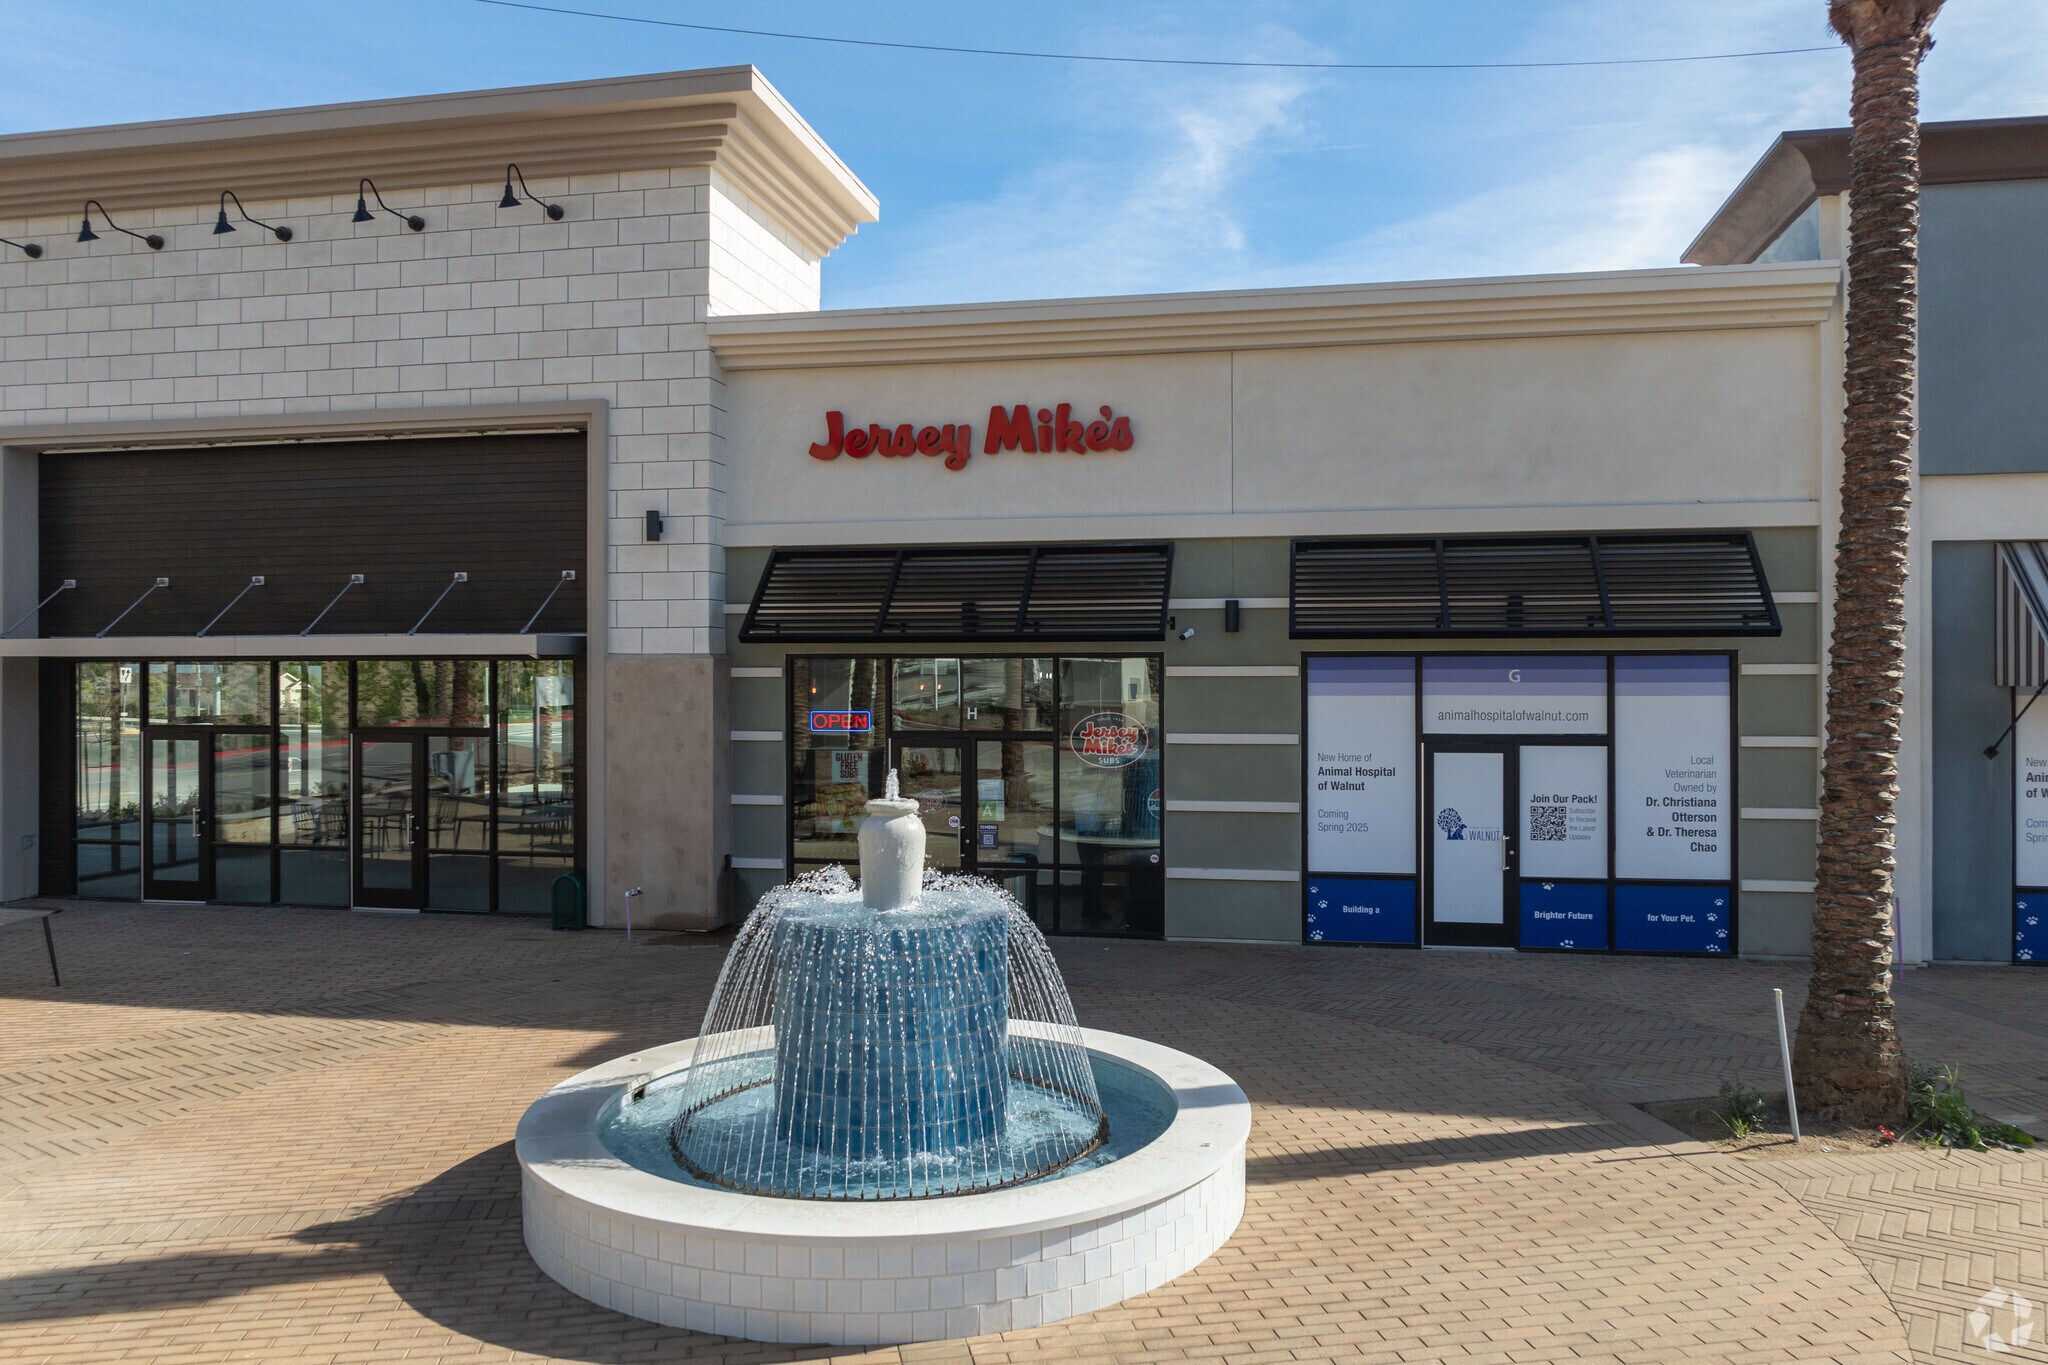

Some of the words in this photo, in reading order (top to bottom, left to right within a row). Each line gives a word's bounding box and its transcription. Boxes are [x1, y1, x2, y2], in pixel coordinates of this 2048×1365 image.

[808, 410, 972, 472] Jersey
[984, 403, 1135, 455] Mike's
[1508, 669, 1521, 682] G
[967, 707, 978, 720] H
[1438, 710, 1589, 723] animalhospitalofwalnut.com
[813, 713, 867, 728] OPEN
[1081, 722, 1138, 743] Jersey
[1083, 738, 1138, 756] Mike's
[835, 752, 863, 762] GLUTEN
[1098, 757, 1120, 765] SUBS
[1318, 753, 1335, 762] New
[1338, 753, 1362, 762] Home
[1364, 753, 1372, 762] of
[1690, 756, 1714, 765] Local
[2026, 758, 2047, 766] New
[840, 761, 858, 770] FREE
[839, 769, 859, 779] SUBS
[1318, 767, 1352, 776] Animal
[1355, 767, 1396, 778] Hospital
[1665, 769, 1717, 778] Veterinarian
[2026, 772, 2048, 782] Ani
[1318, 781, 1328, 790] of
[1330, 781, 1365, 790] Walnut
[1674, 783, 1704, 792] Owned
[1706, 783, 1717, 794] by
[2026, 788, 2038, 798] of
[1530, 794, 1550, 803] Join
[1552, 794, 1569, 804] Our
[1571, 794, 1598, 804] Pack!
[1646, 797, 1660, 807] Dr.
[1663, 797, 1717, 807] Christiana
[982, 804, 993, 817] A
[1318, 809, 1349, 820] Coming
[1672, 812, 1717, 822] Otterson
[1318, 822, 1344, 833] Spring
[1346, 823, 1369, 832] 2025
[1646, 827, 1654, 837] &
[1658, 827, 1672, 837] Dr.
[1675, 827, 1717, 837] Theresa
[1469, 830, 1500, 841] WALNUT
[1690, 842, 1717, 852] Chao
[1342, 905, 1374, 915] Building
[1534, 911, 1566, 921] Brighter
[1568, 912, 1594, 920] Future
[1647, 913, 1660, 922] for
[1661, 914, 1679, 923] Your
[1680, 915, 1696, 923] Pet.
